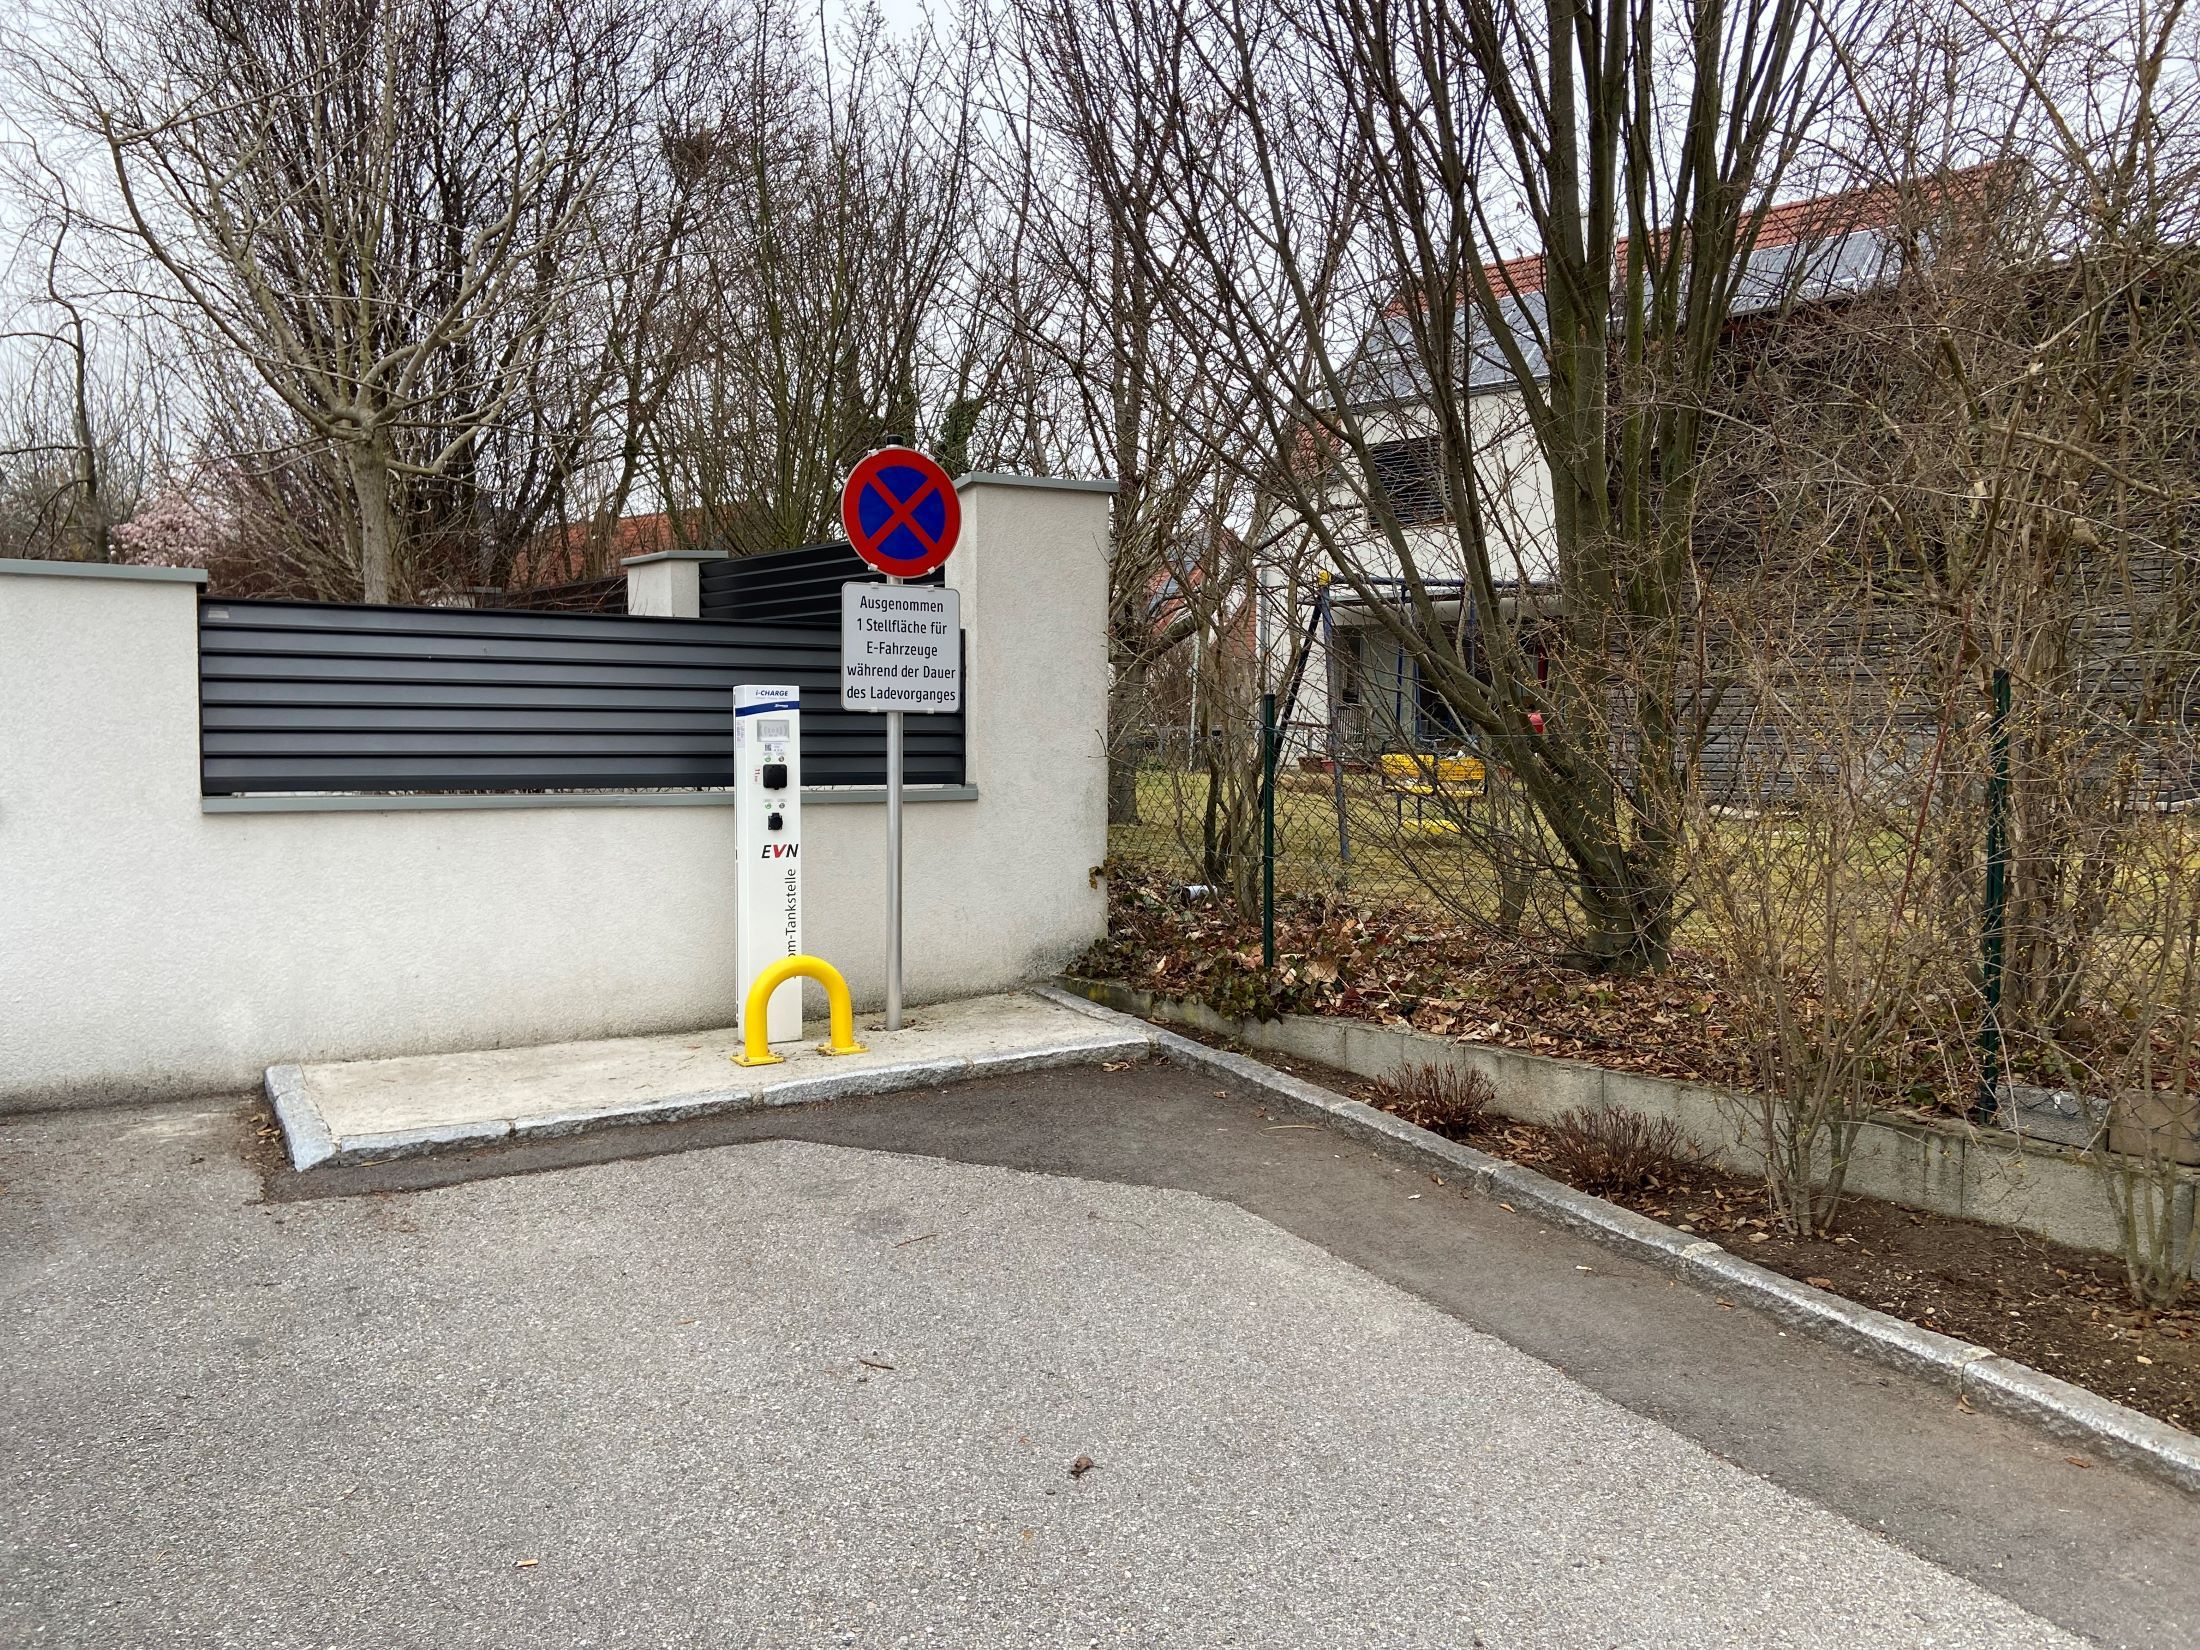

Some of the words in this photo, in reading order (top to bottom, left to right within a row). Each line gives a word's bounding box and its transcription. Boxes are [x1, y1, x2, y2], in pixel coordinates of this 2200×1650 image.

[860, 595, 944, 612] Ausgenommen
[857, 618, 862, 631] 1
[866, 618, 927, 634] Stellfläche
[930, 621, 947, 635] für
[867, 641, 938, 659] E-Fahrzeuge
[847, 663, 898, 678] während
[901, 665, 919, 678] der
[923, 665, 956, 679] Dauer
[755, 689, 789, 697] i-CHARGE
[846, 685, 866, 699] des
[870, 686, 956, 703] Ladevorganges
[761, 843, 799, 859] EVN
[784, 868, 797, 979] m-Tankstelle
